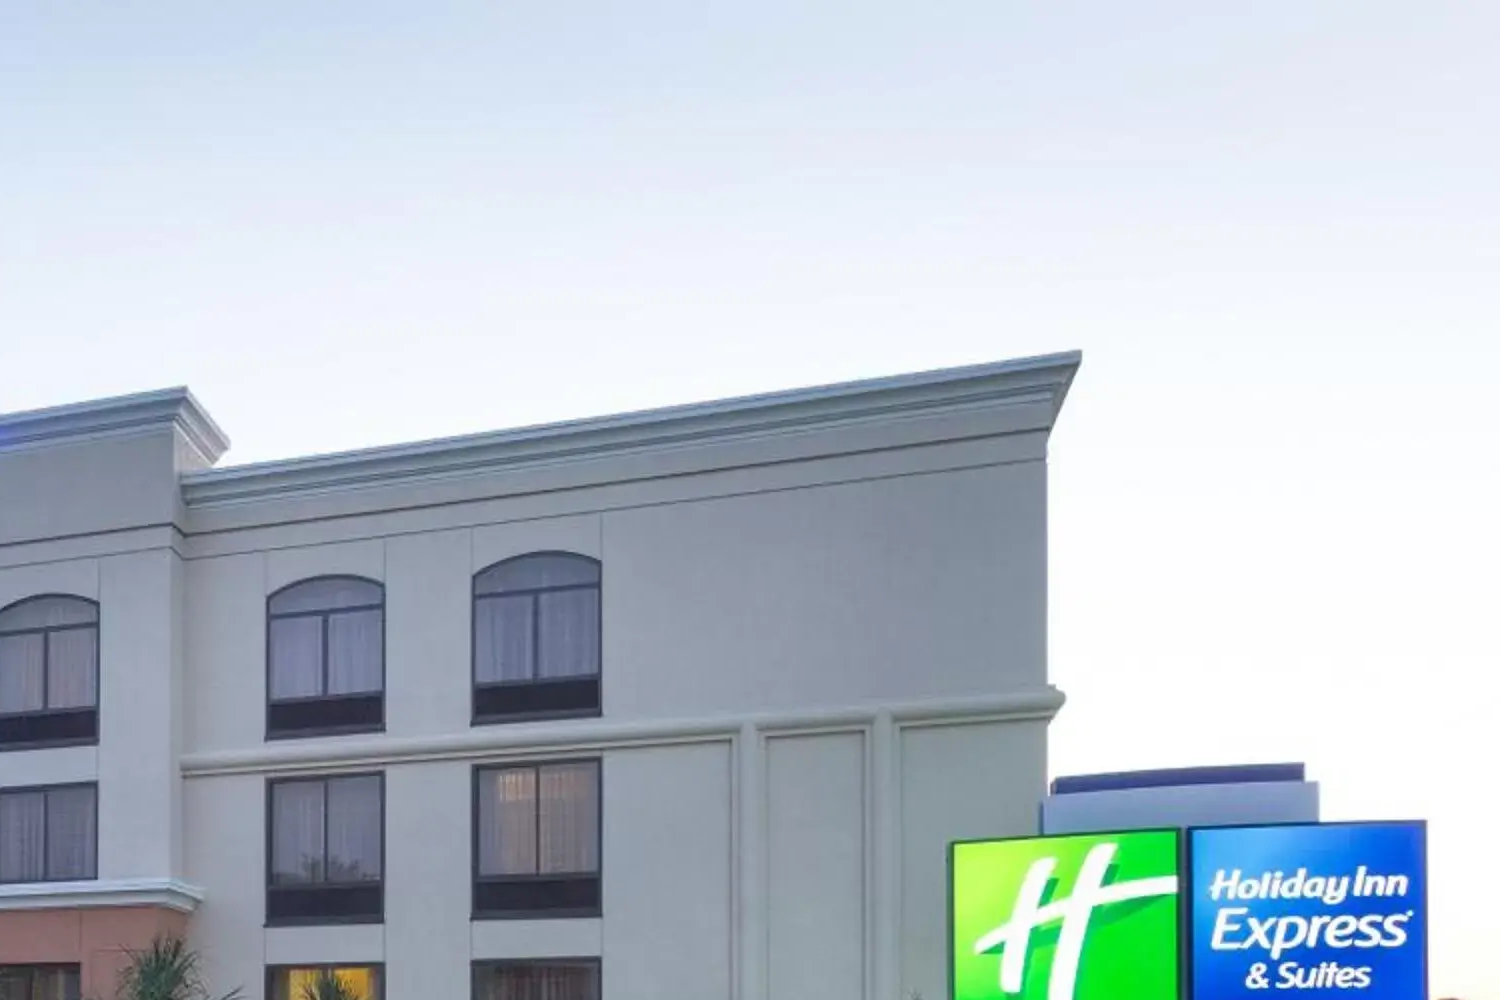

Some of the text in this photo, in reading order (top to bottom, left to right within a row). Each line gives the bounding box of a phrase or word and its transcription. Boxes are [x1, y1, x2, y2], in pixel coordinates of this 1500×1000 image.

[1209, 864, 1409, 905] Holiday Inn
[1210, 907, 1409, 961] Express
[1244, 961, 1373, 990] & Suites
